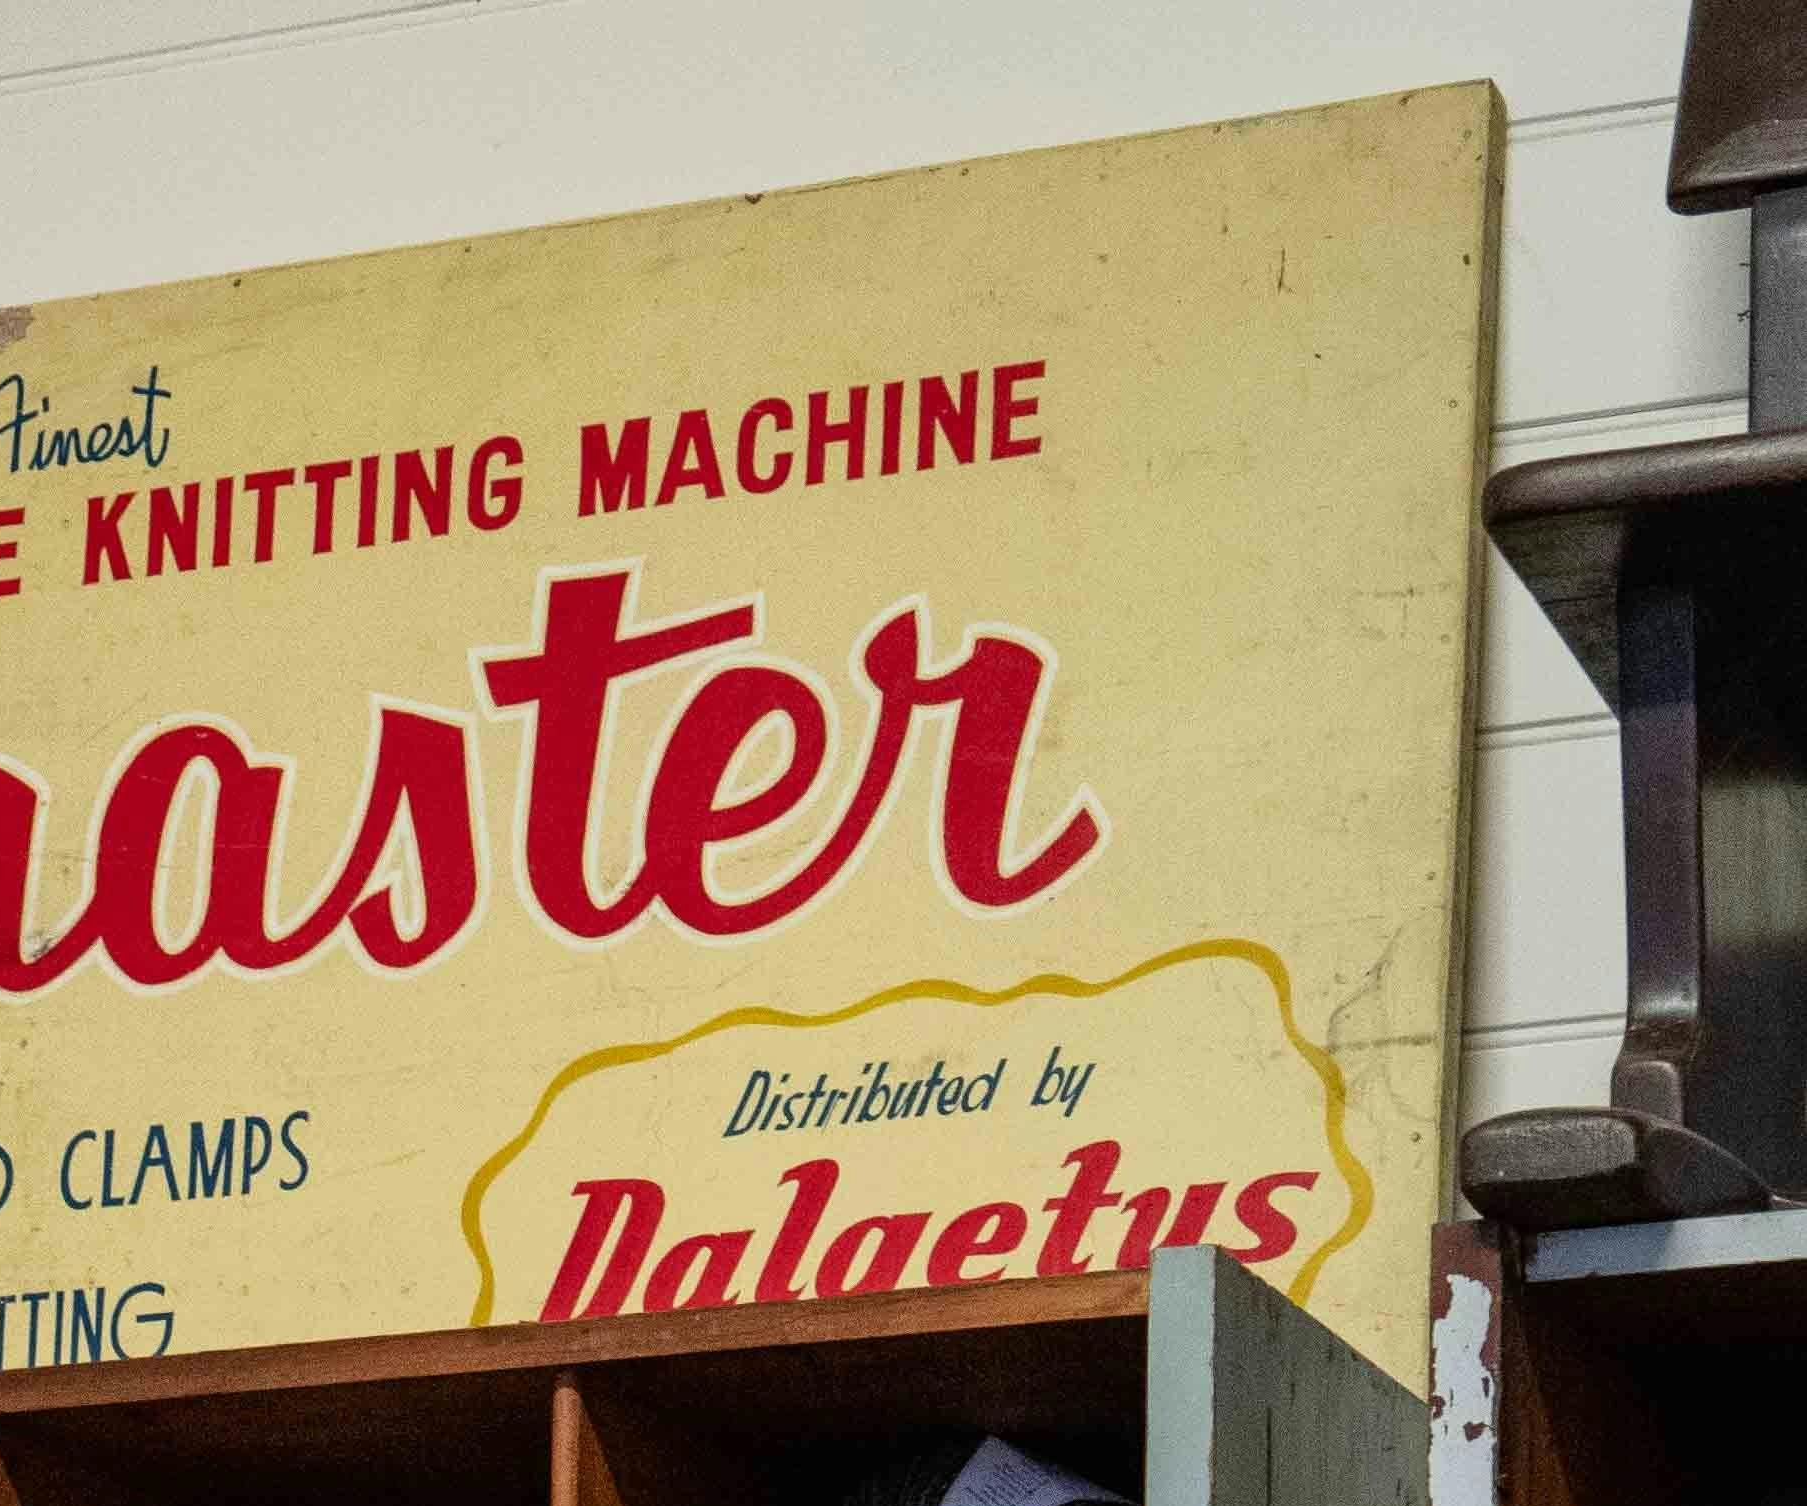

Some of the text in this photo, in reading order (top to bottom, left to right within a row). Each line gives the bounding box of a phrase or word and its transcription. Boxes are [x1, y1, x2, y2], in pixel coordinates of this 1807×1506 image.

[82, 434, 524, 587] KNITTING
[576, 359, 1047, 519] MACHINE
[722, 1045, 1097, 1138] Distributed by
[59, 1109, 310, 1212] CLAMPS
